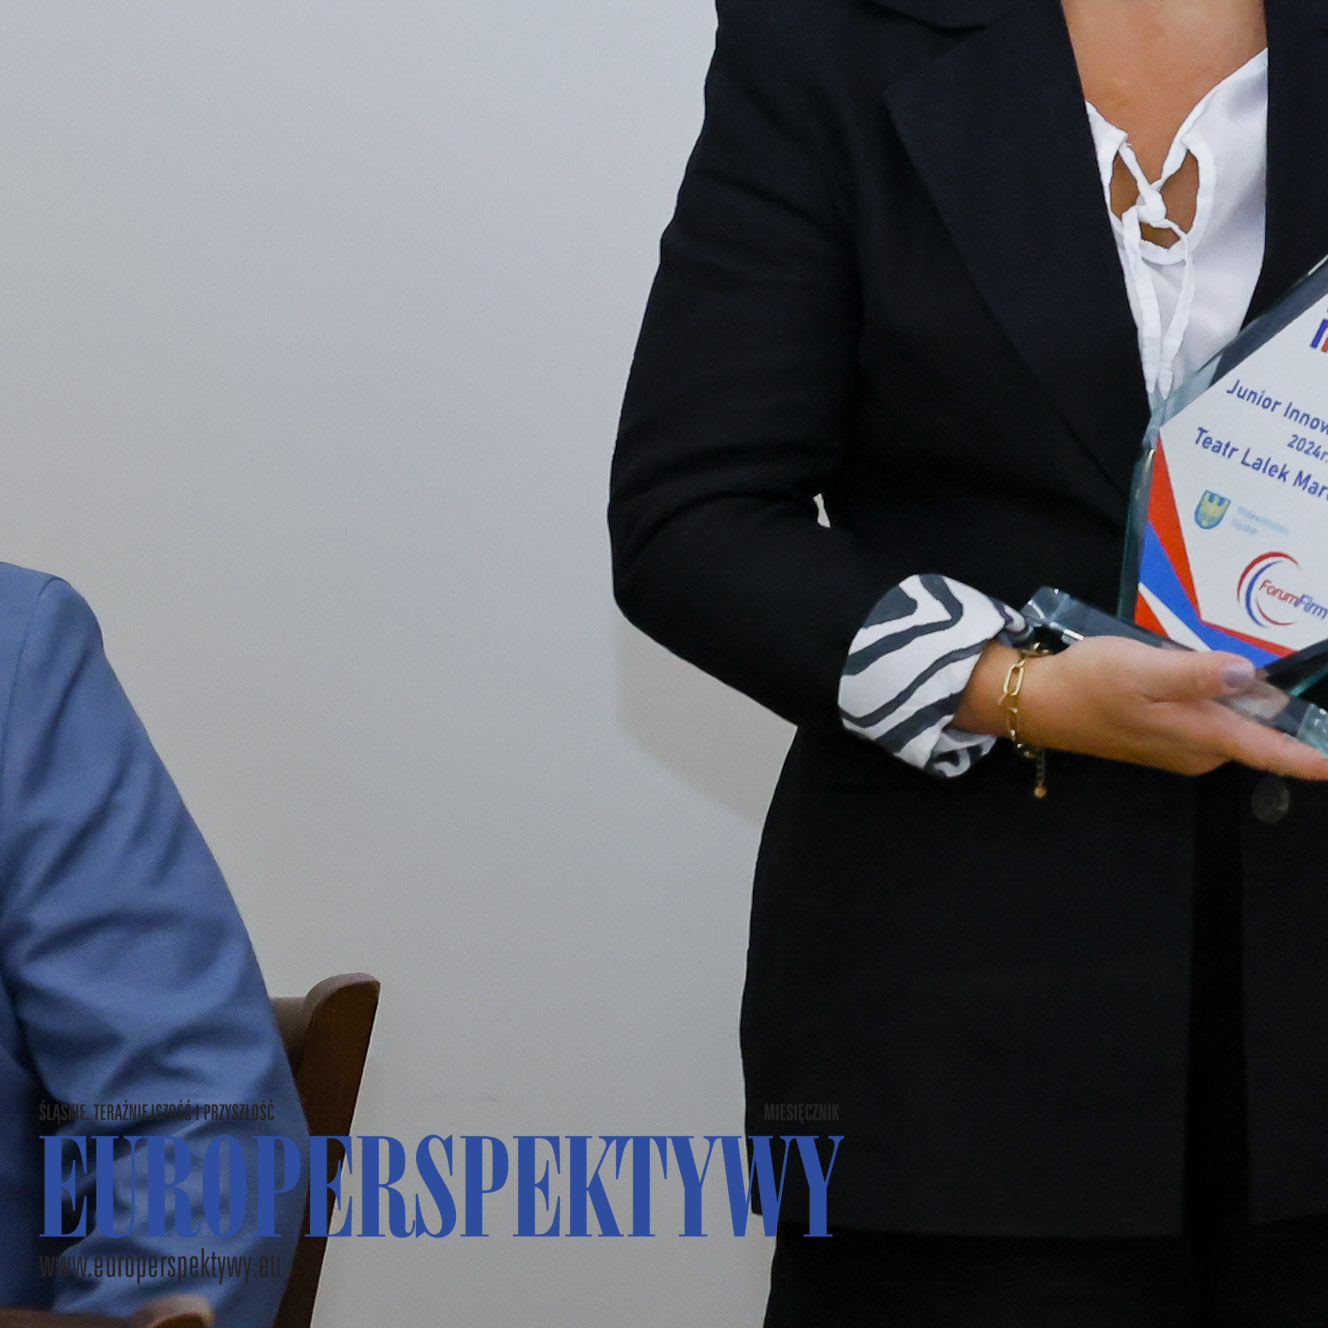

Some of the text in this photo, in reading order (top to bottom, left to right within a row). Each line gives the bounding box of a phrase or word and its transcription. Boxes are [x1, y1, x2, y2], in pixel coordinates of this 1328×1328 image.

[1226, 379, 1282, 412] Junior
[1194, 426, 1239, 460] Teatr
[1241, 448, 1291, 483] Lalek
[1286, 434, 1328, 464] 2024r.
[1258, 579, 1328, 620] ForumFirm
